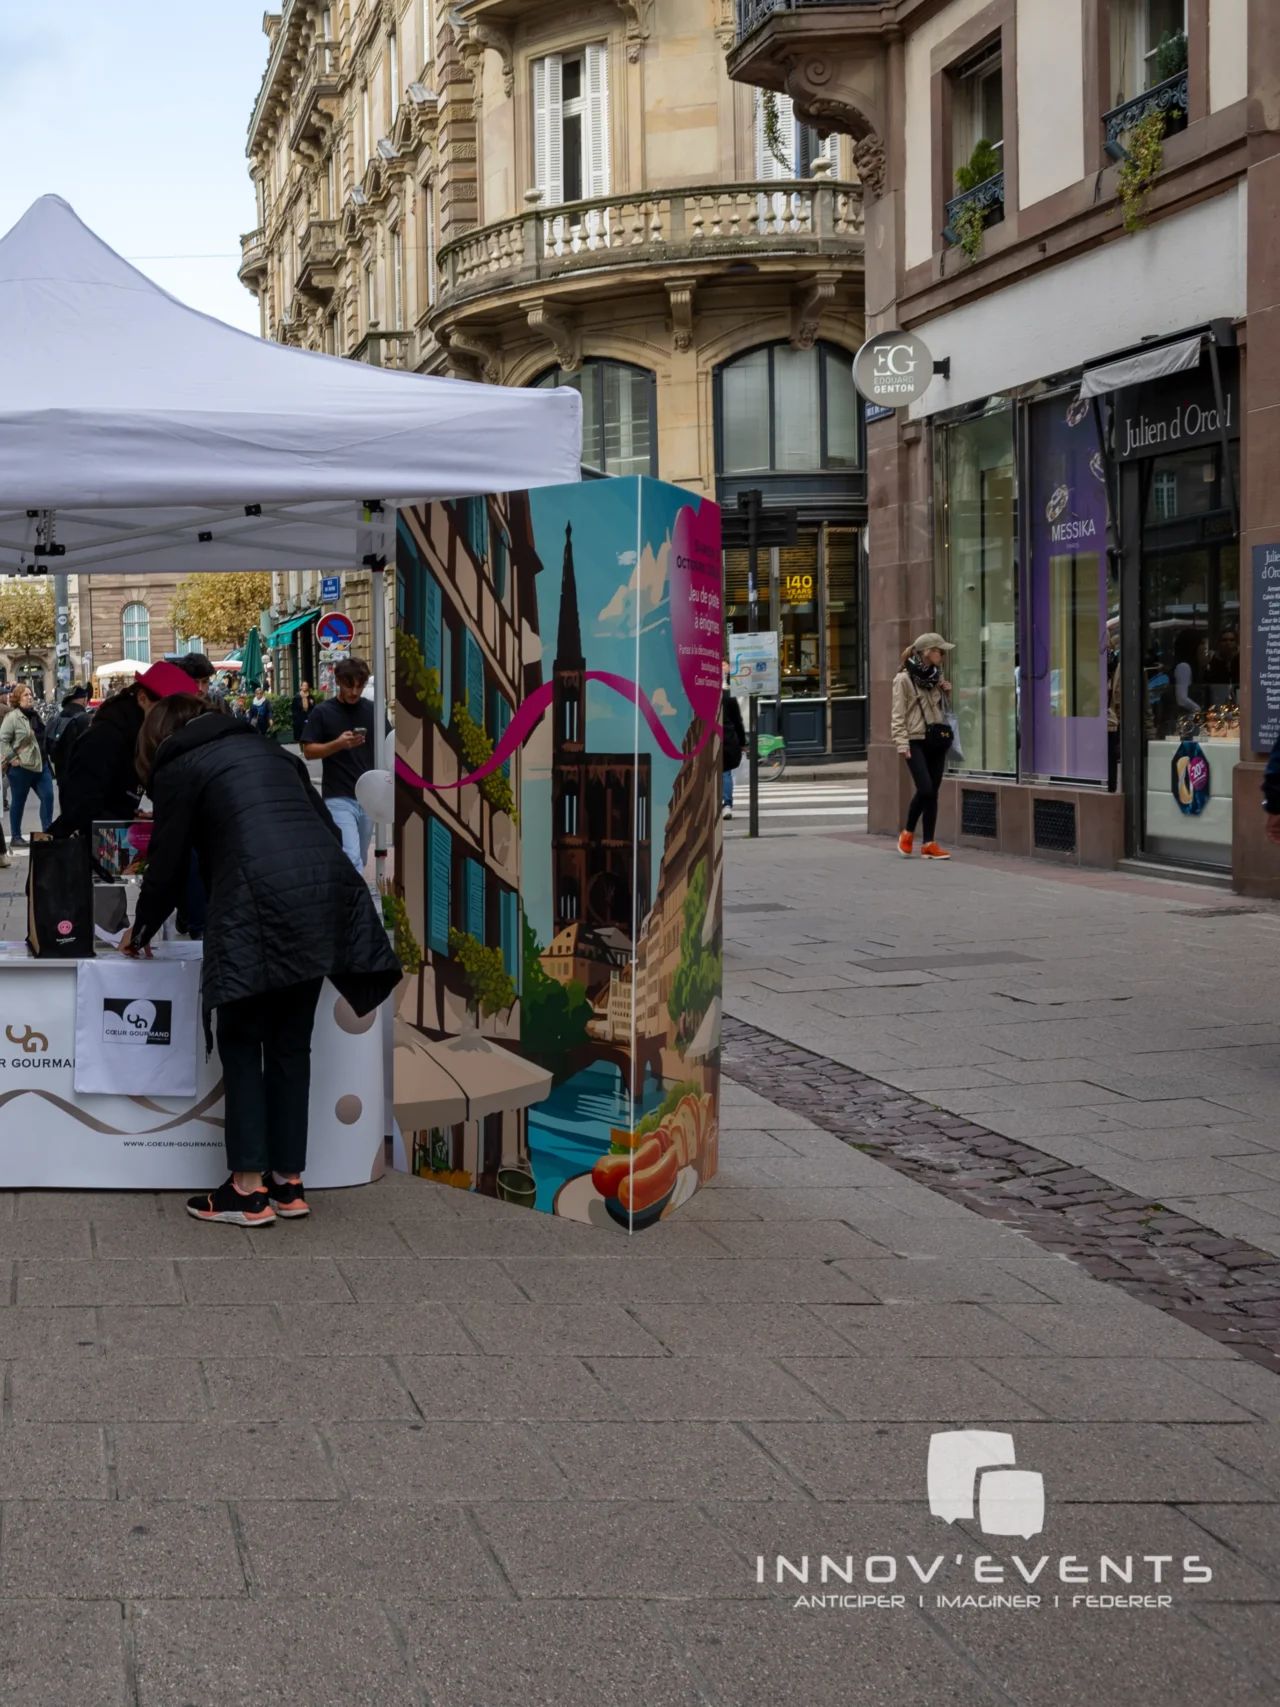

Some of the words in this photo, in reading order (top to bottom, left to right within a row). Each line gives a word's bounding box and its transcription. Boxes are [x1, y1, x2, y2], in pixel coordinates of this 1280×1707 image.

[873, 344, 918, 376] EG
[874, 384, 915, 394] GENTON
[1122, 415, 1167, 456] Julien
[1051, 518, 1097, 542] MESSIKA
[786, 575, 813, 589] 140
[689, 583, 699, 601] Jeu
[700, 585, 707, 604] de
[129, 1030, 170, 1038] GOURMAND
[11, 1058, 76, 1068] GOURMA
